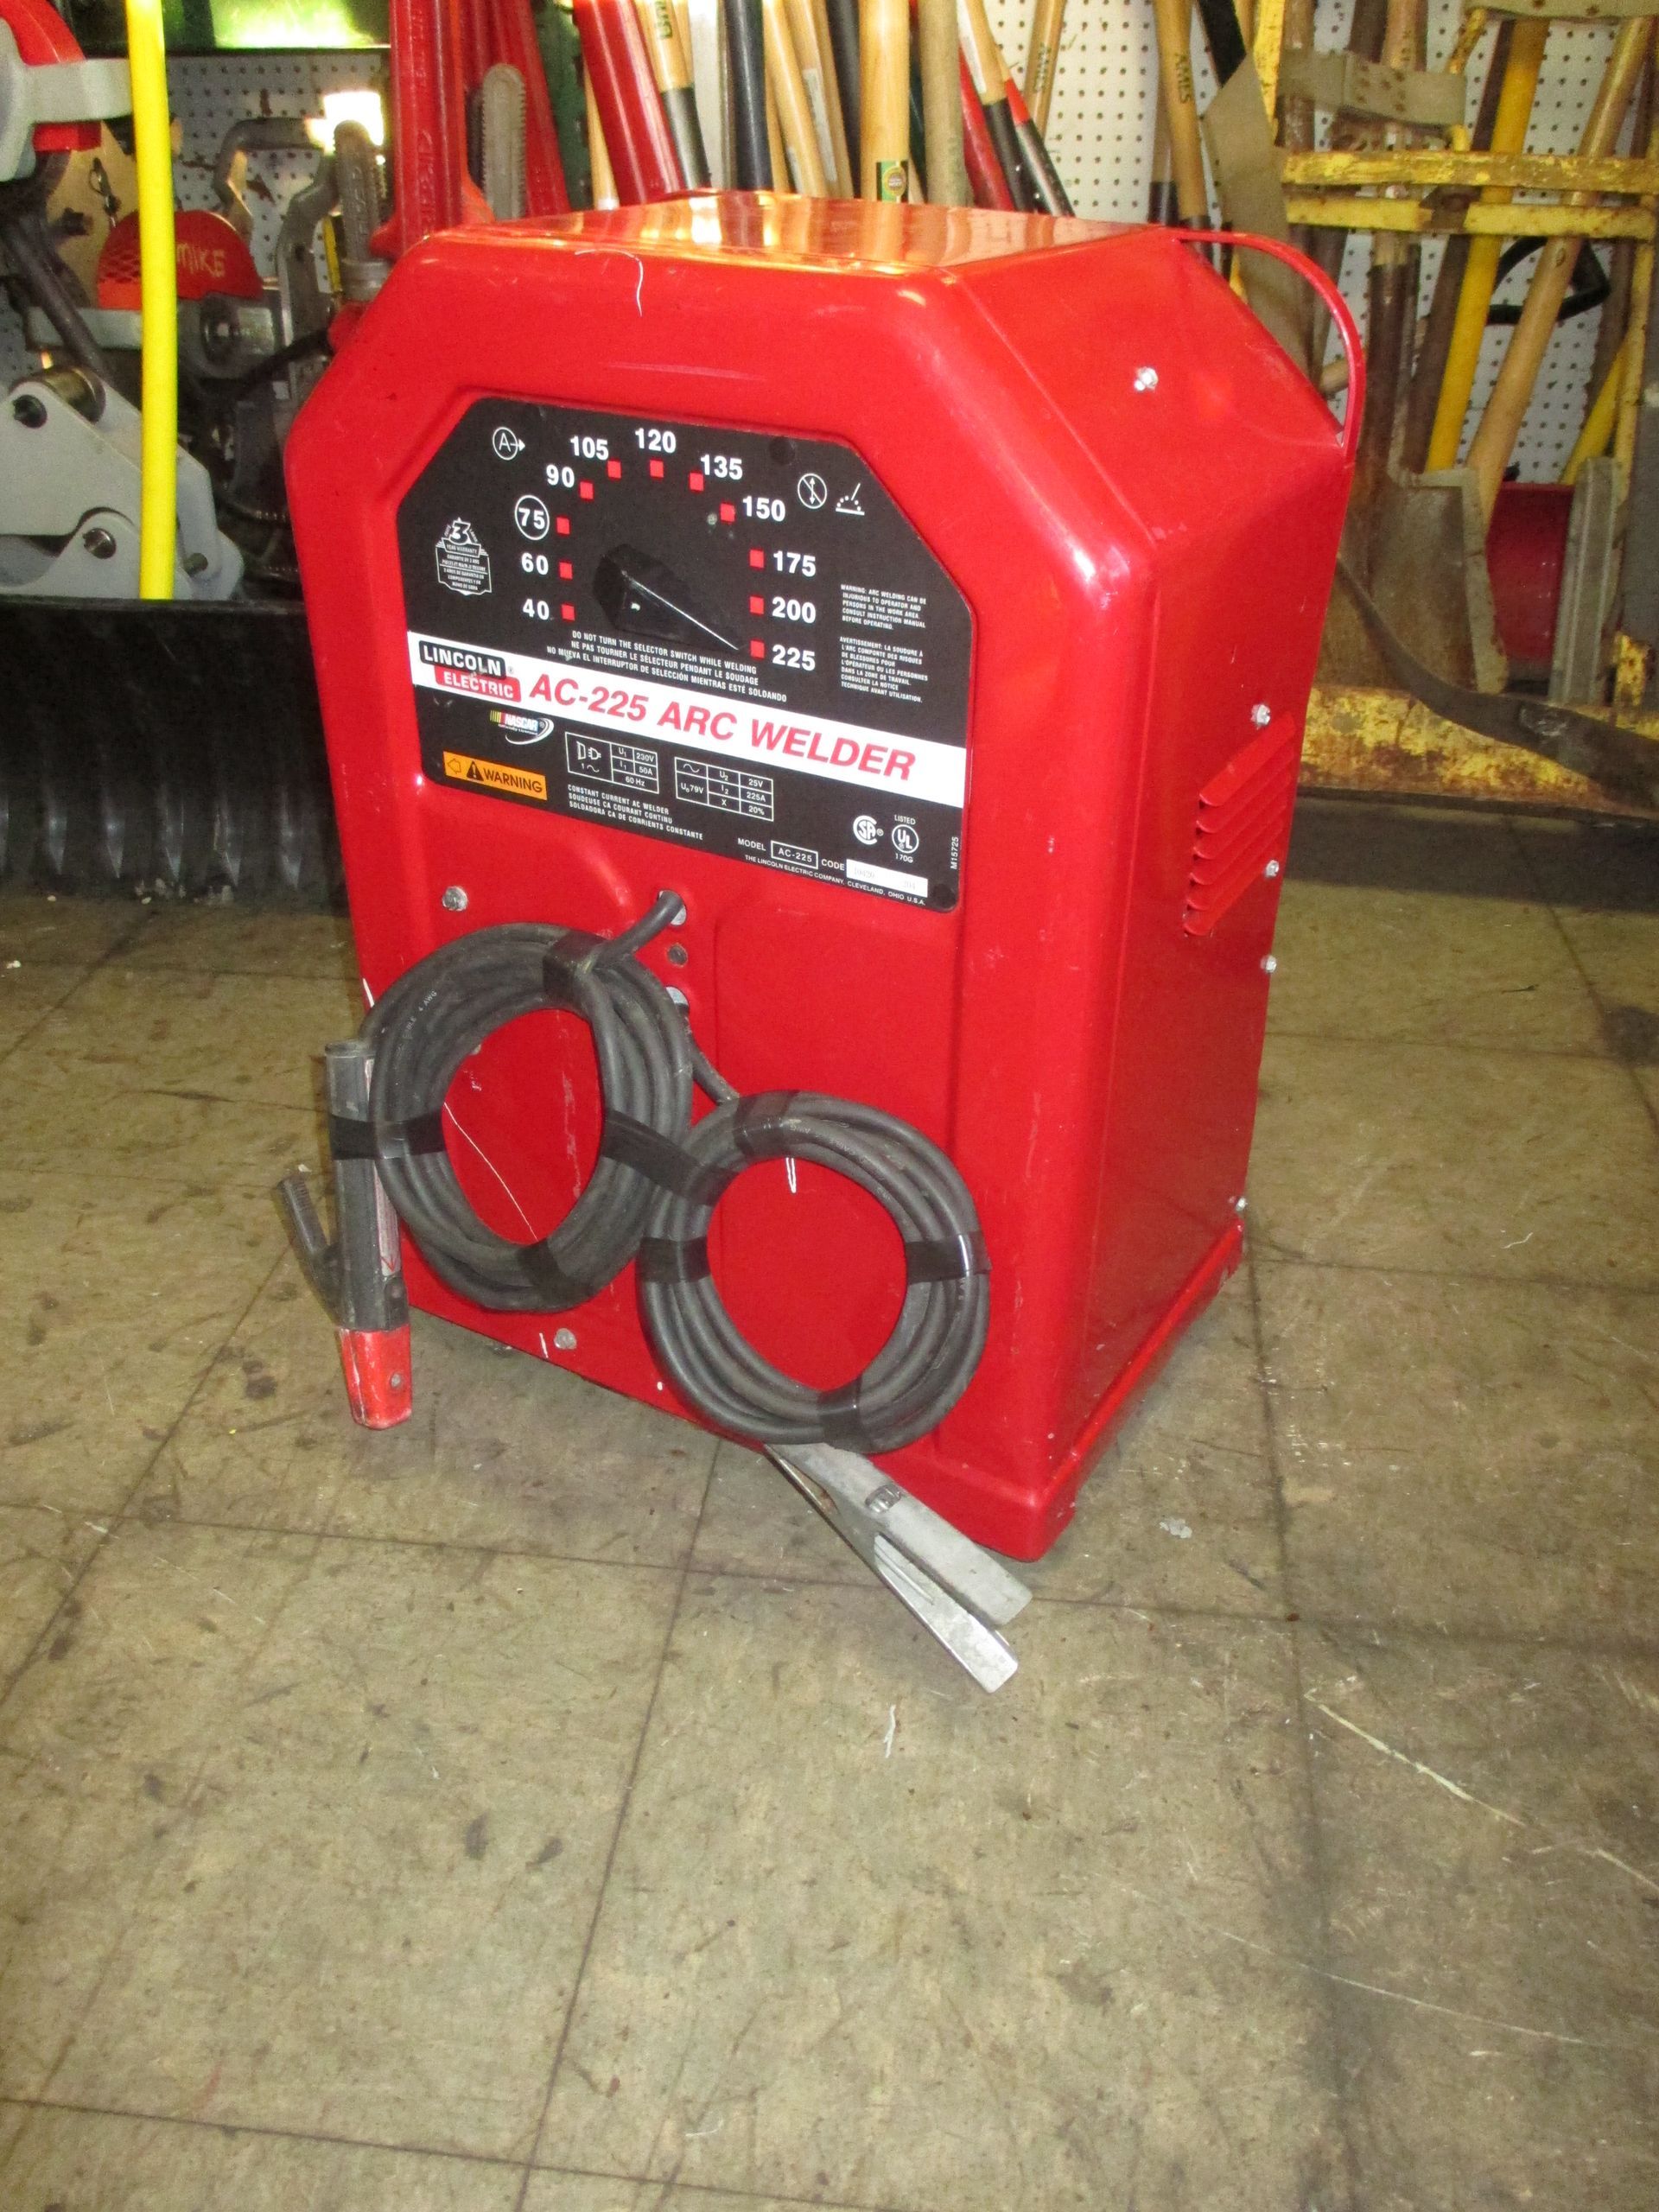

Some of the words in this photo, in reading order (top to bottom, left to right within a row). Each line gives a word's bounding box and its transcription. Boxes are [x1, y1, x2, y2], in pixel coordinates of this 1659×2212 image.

[570, 435, 609, 461] 105
[635, 428, 677, 454] 120
[546, 465, 575, 488] 90
[701, 454, 743, 480] 135
[518, 507, 545, 530] 75
[742, 495, 785, 522] 150
[449, 520, 471, 545] 3
[521, 552, 549, 575] 60
[773, 550, 817, 577] 175
[841, 583, 867, 594] WARNING:
[880, 591, 906, 600] WELDING
[842, 592, 870, 602] INJURIOUS
[880, 598, 908, 608] OPERATOR
[522, 598, 550, 620] 40
[772, 596, 816, 624] 200
[842, 600, 866, 609] PERSONS
[887, 607, 903, 616] WORK
[842, 607, 865, 617] CONSULT
[867, 612, 902, 624] INSTRUCTION
[903, 619, 925, 628] MANUAL
[842, 615, 861, 624] BEFORE
[423, 645, 501, 677] LINCOLN
[571, 640, 580, 649] NE
[582, 642, 594, 652] PAS
[597, 645, 627, 658] TOURNER
[681, 663, 712, 676] PENDANT
[715, 670, 722, 678] LE
[725, 672, 759, 686] SOUDAGE
[572, 630, 582, 639] DO
[583, 632, 596, 641] NOT
[599, 635, 617, 646] TURN
[619, 639, 632, 650] THE
[634, 642, 668, 657] SELECTOR
[671, 650, 697, 663] SWITCH
[699, 656, 721, 667] WHILE
[724, 661, 757, 675] WELDING
[772, 644, 817, 672] 225
[858, 646, 886, 658] COMPORTE
[899, 655, 922, 665] RISQUES
[443, 671, 514, 699] ELECTRIC
[547, 645, 556, 655] NO
[558, 648, 581, 659] MUEVA
[582, 652, 590, 662] EL
[593, 655, 638, 671] INTERRUPTOR
[640, 664, 649, 674] DE
[652, 668, 689, 682] SELECCIÓN
[691, 676, 726, 690] MIENTRAS
[748, 688, 787, 702] SOLDANDO
[841, 674, 871, 685] CONSULTER
[880, 681, 899, 691] NOTICE
[865, 671, 878, 679] ZONE
[897, 670, 928, 682] PERSONNES
[841, 681, 869, 692] TECHNIQUE
[870, 687, 887, 696] AVANT
[505, 714, 538, 732] NASCAR
[530, 673, 649, 721] AC-225
[657, 701, 737, 741] ARC
[751, 718, 916, 780] WELDER
[636, 753, 655, 762] 230V
[483, 768, 543, 793] WARNING
[626, 776, 635, 785] 60
[636, 779, 645, 787] Hz
[639, 766, 653, 776] 50A
[748, 779, 763, 788] 25V
[568, 785, 599, 798] CONSTANT
[601, 792, 630, 805] CURRENT
[632, 799, 640, 808] AC
[643, 803, 669, 815] WELDER
[569, 793, 601, 806] SOUDEUSE
[613, 804, 642, 817] COURANT
[645, 810, 673, 823] CONTINU
[747, 791, 766, 803] 225A
[569, 800, 605, 815] SOLDADORA
[666, 825, 703, 839] CONSTANTE
[748, 805, 765, 816] 20%
[894, 814, 916, 825] LISTED
[897, 829, 913, 849] UL
[738, 838, 766, 851] MODEL
[778, 848, 812, 863] AC-225
[821, 859, 845, 871] CODE
[895, 853, 913, 863] 170G
[950, 836, 959, 870] M15725
[757, 858, 783, 869] LINCOLN
[784, 865, 813, 876] ELECTRIC
[888, 891, 905, 900] OHIO
[906, 896, 925, 906] U.S.A.
